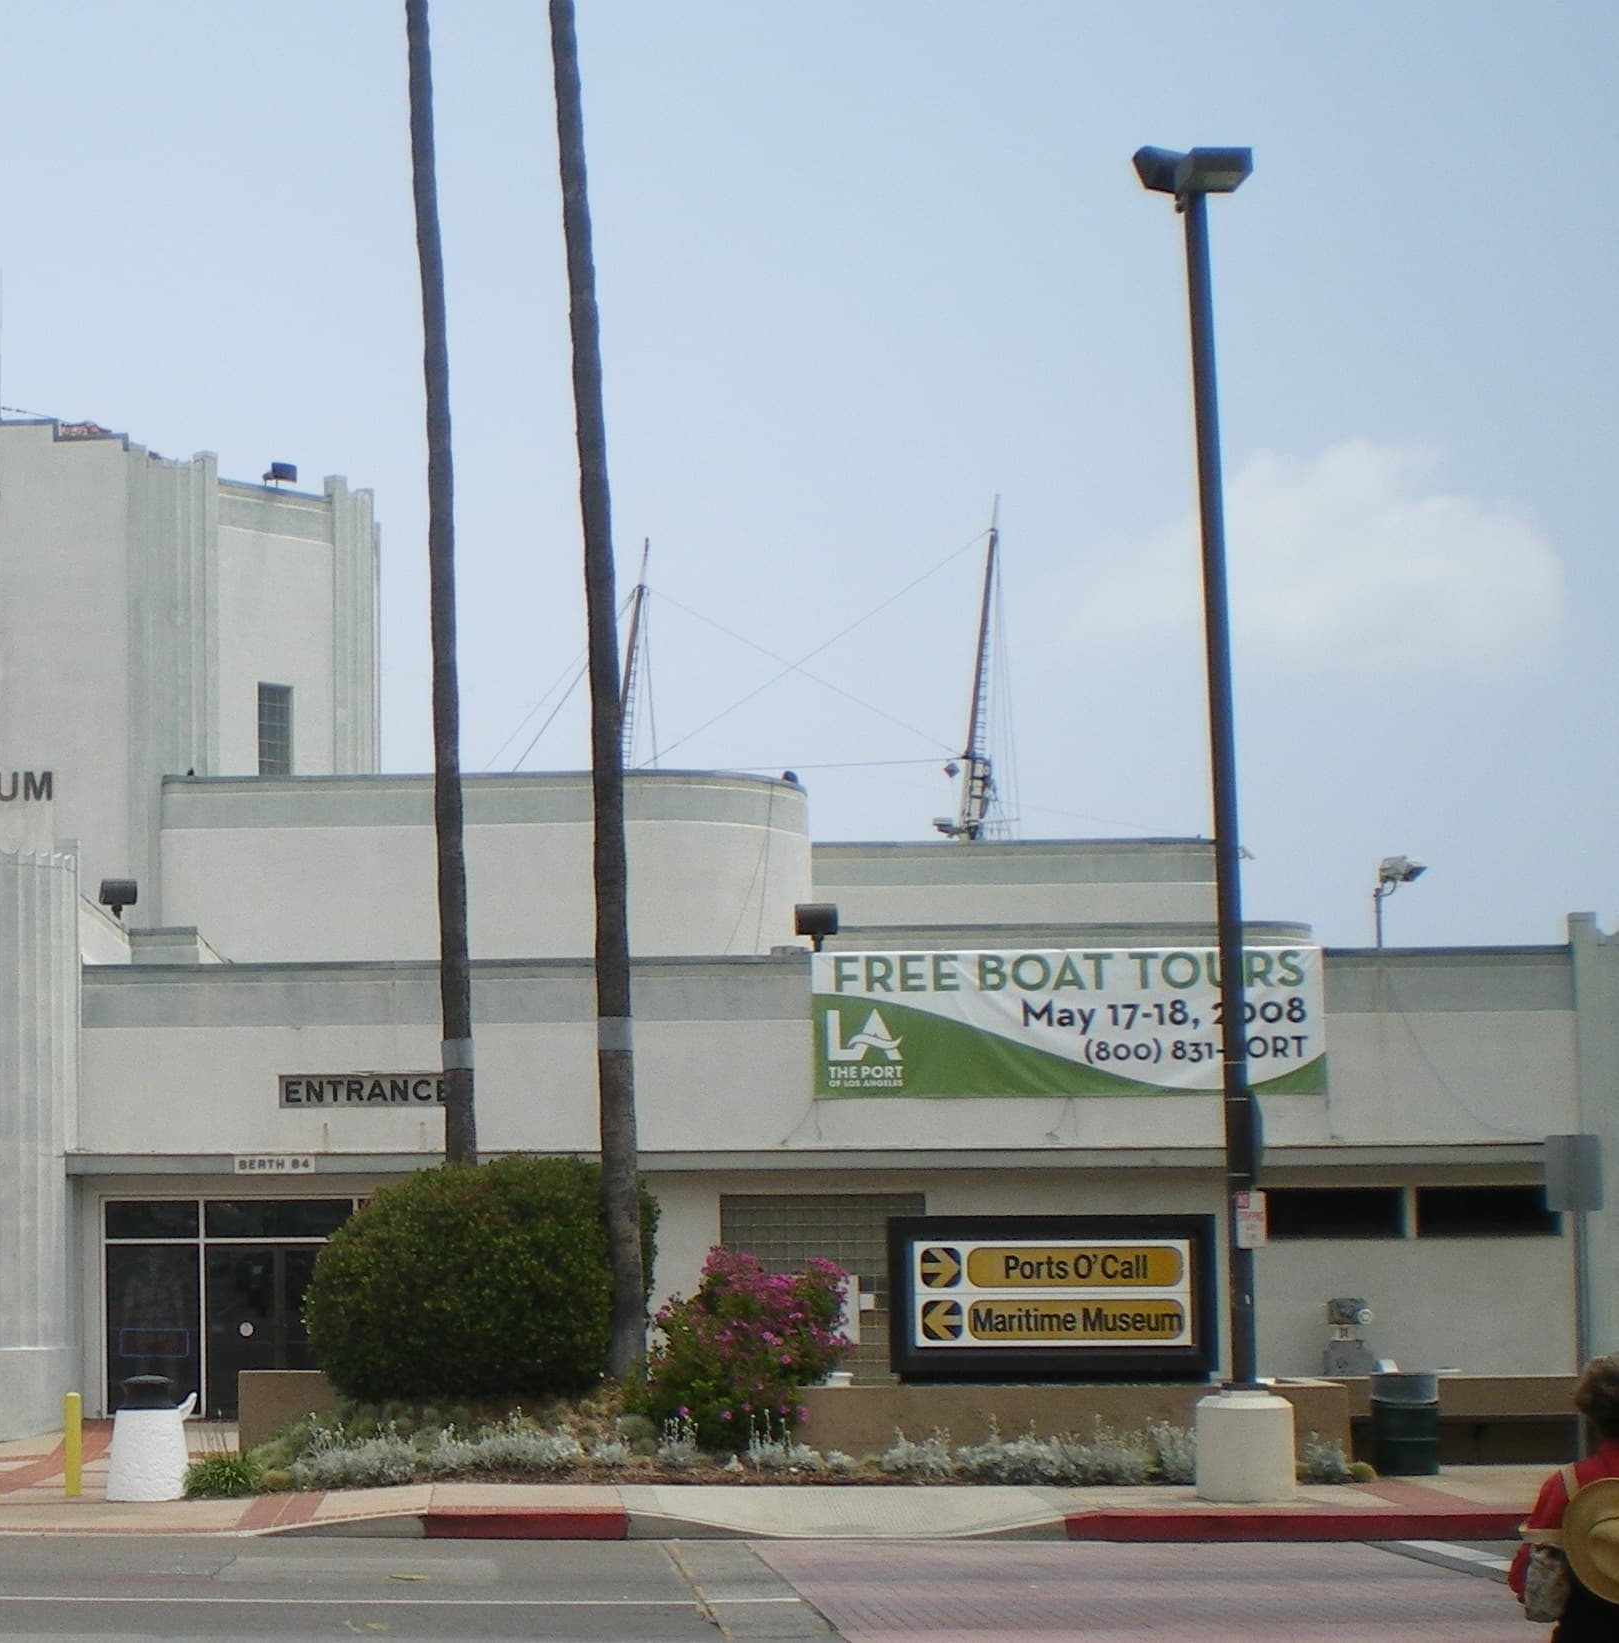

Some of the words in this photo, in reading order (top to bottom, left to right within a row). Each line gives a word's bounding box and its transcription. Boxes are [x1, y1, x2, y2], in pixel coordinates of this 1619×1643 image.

[834, 953, 960, 993] FREE
[978, 952, 1118, 991] BOAT
[1021, 999, 1097, 1035] May
[1107, 998, 1201, 1030] 17-18,
[826, 1008, 903, 1061] LA
[1085, 1037, 1162, 1065] (800)
[1171, 1036, 1308, 1063] 831-ORT
[828, 1065, 859, 1079] THE
[861, 1065, 904, 1079] PORT
[828, 1079, 841, 1088] OF
[843, 1079, 861, 1088] LOS
[862, 1079, 904, 1088] ANGELES
[238, 1159, 285, 1170] BERTH
[1004, 1255, 1068, 1279] Ports
[1073, 1254, 1148, 1280] O'Call
[973, 1308, 1077, 1333] Maritime
[1082, 1307, 1181, 1332] Museum
